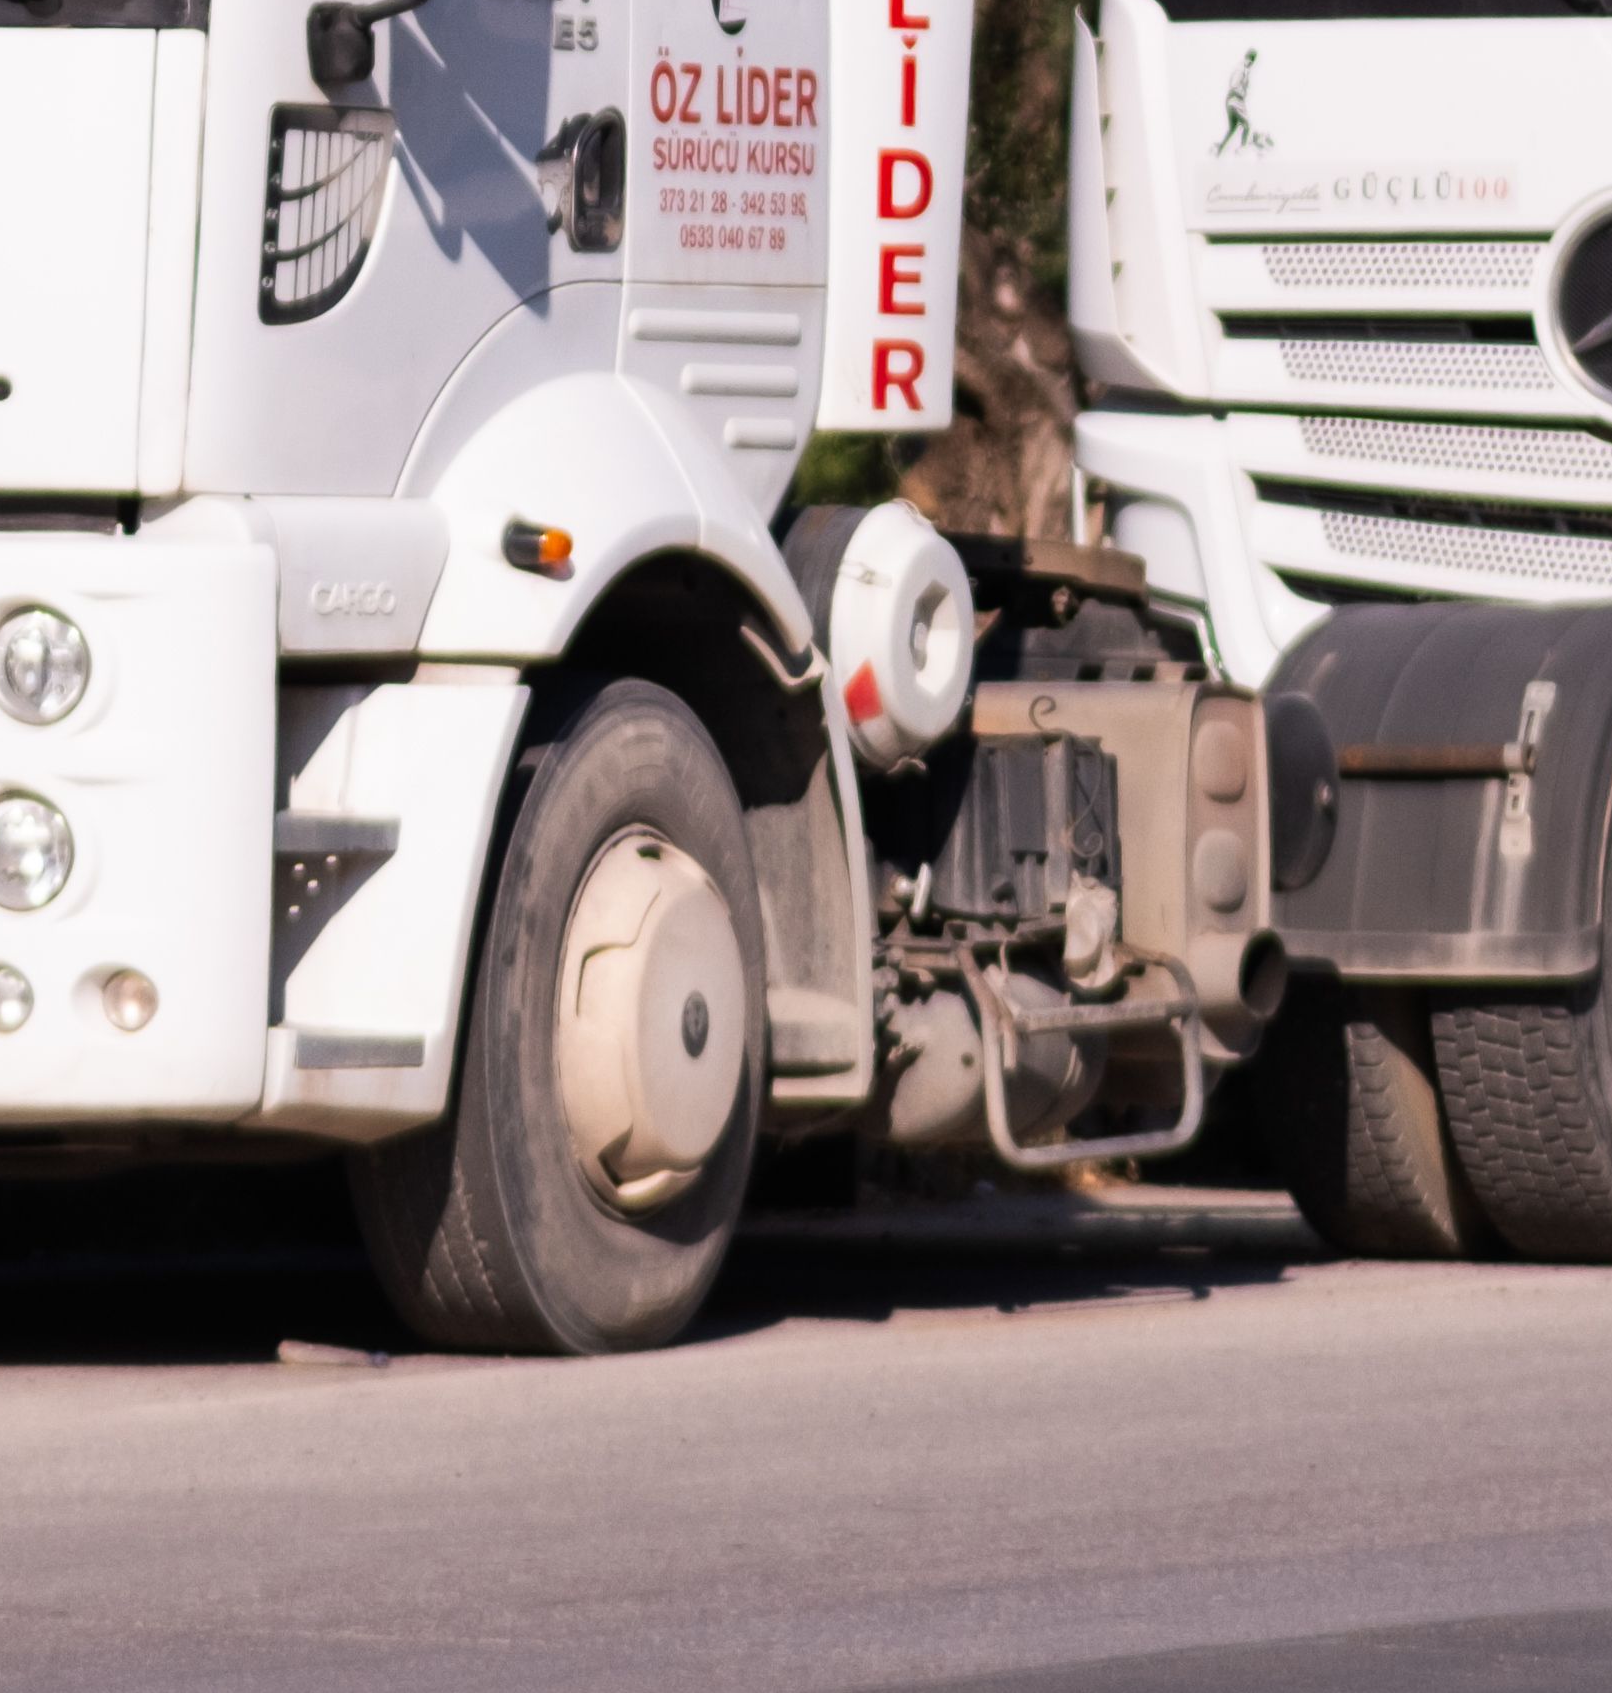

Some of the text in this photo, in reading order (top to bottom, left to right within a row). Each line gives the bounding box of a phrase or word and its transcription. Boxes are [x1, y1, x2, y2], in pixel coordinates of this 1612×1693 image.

[551, 16, 600, 52] E5
[651, 46, 818, 127] ÖZ LİDER
[653, 129, 815, 176] SÜRÜCÜ KURSU
[660, 188, 686, 213] 373
[689, 189, 704, 213] 21
[711, 190, 728, 214] 28
[740, 190, 766, 215] 342
[770, 192, 786, 216] 53
[680, 224, 786, 251] 0533 040 67 89
[310, 580, 396, 617] CARGO
